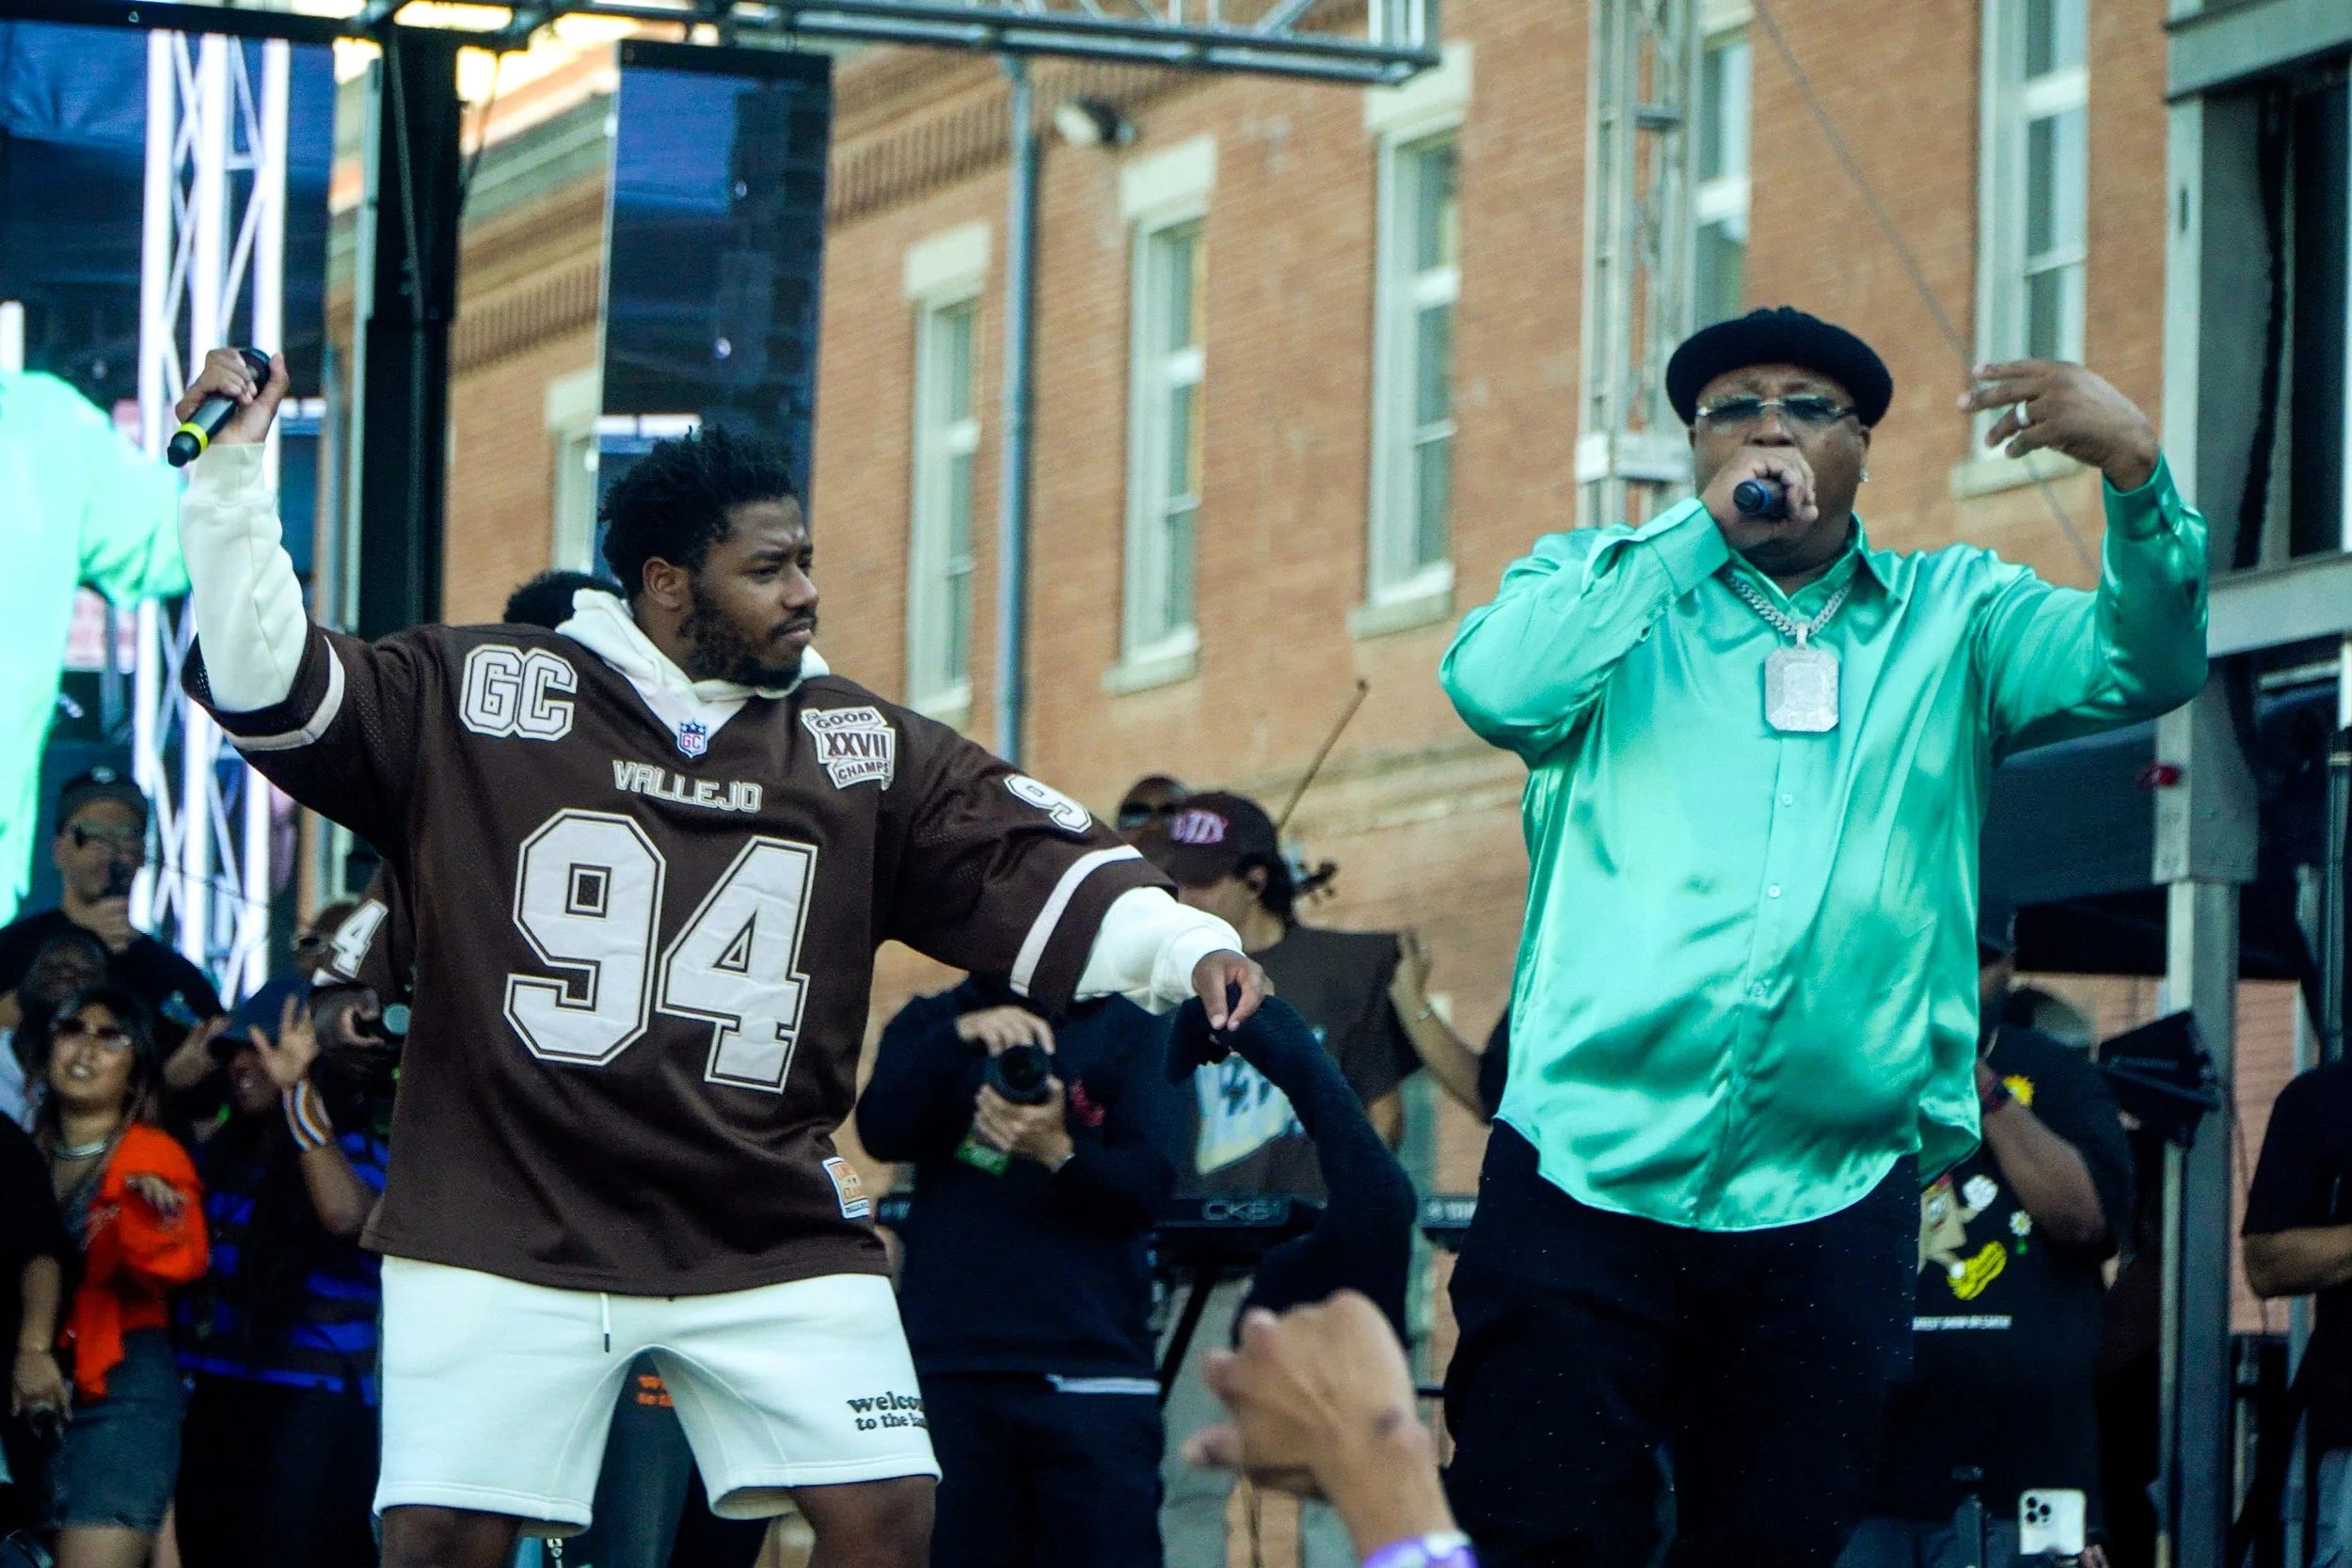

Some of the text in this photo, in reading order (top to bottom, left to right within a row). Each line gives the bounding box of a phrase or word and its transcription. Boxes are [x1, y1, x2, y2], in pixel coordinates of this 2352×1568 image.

[459, 643, 579, 741] GC
[816, 712, 873, 729] GOOD
[682, 734, 702, 750] GC
[824, 732, 887, 759] XXVII
[838, 761, 889, 780] CHAMPS
[612, 759, 763, 813] VALLEJO
[329, 898, 389, 978] 4
[503, 808, 818, 1095] 94
[855, 1418, 877, 1431] to
[881, 1413, 909, 1428] the
